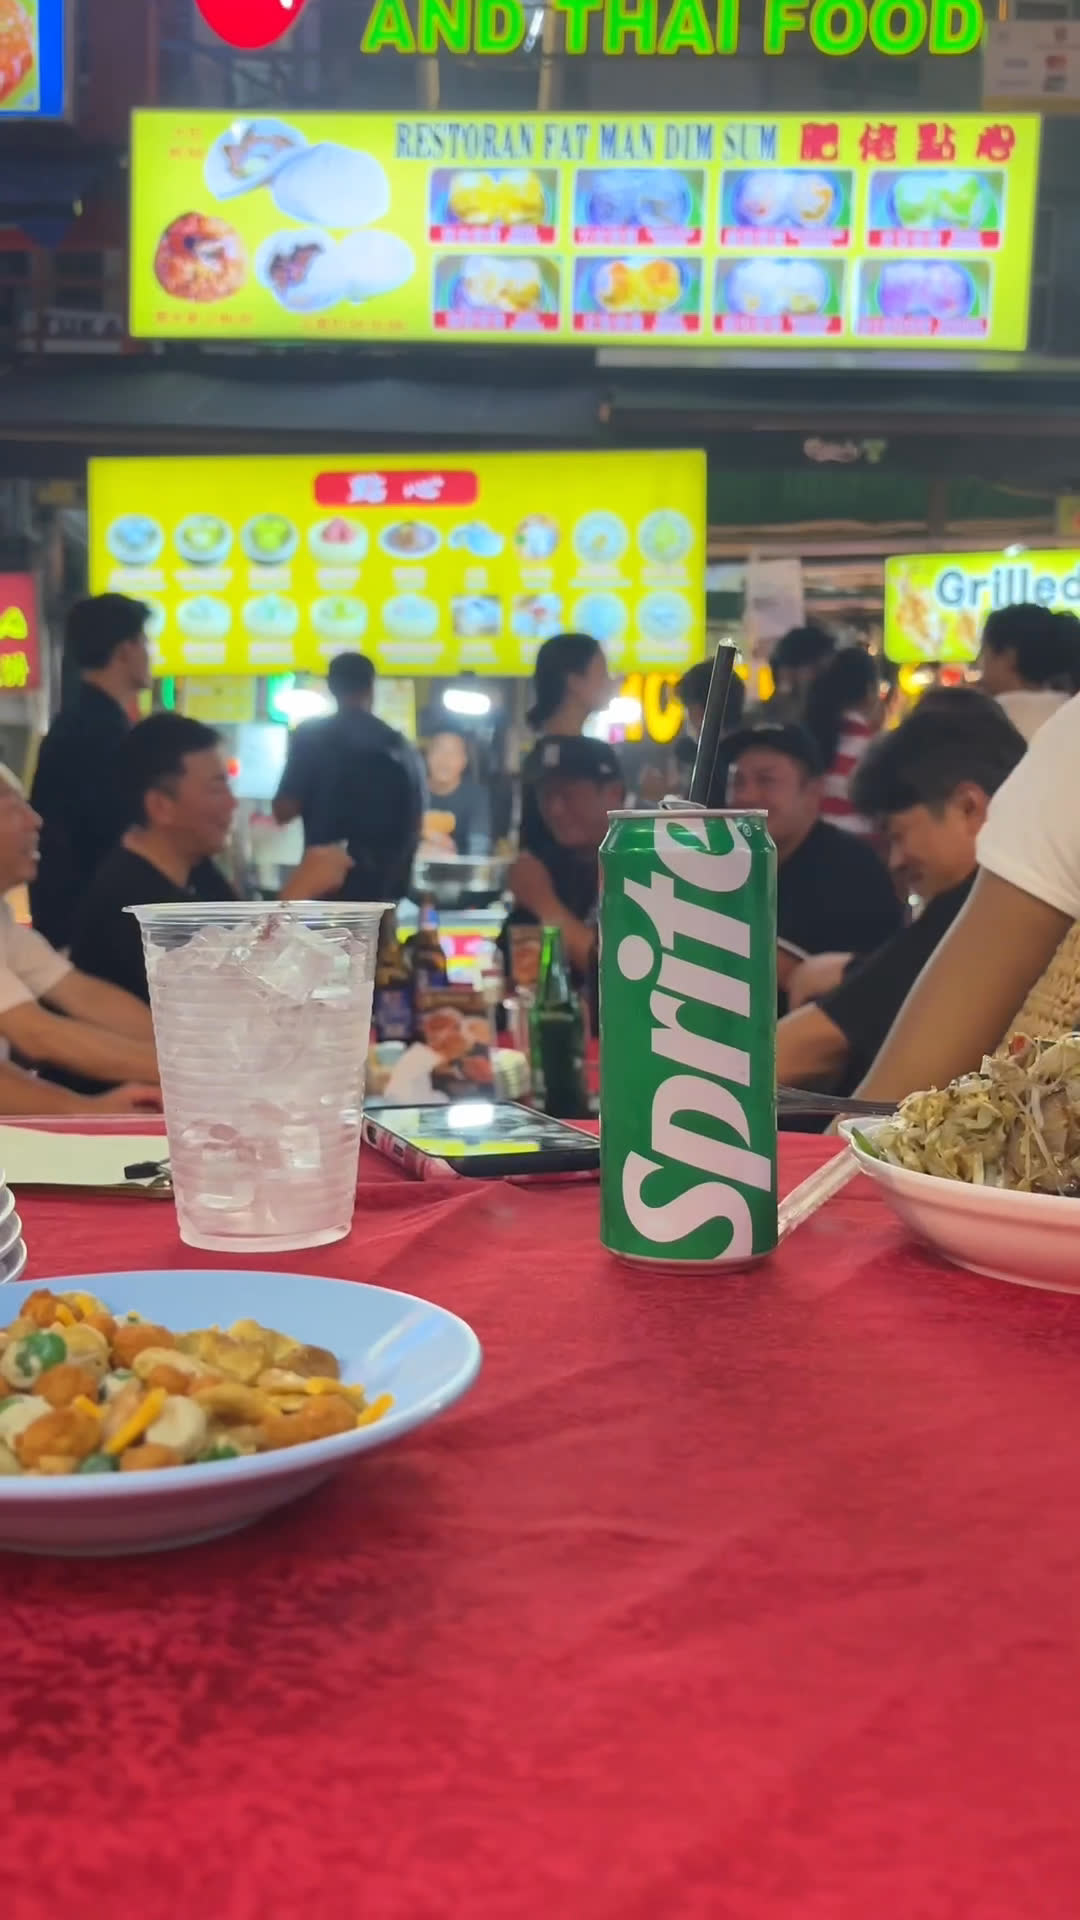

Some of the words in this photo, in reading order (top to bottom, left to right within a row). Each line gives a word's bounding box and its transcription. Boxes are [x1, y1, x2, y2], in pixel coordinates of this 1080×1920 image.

[361, 0, 528, 54] AND
[555, 0, 740, 55] THAI
[764, 0, 984, 56] FOOD
[396, 122, 534, 159] RESTORAN
[543, 123, 590, 160] FAT
[599, 123, 655, 161] MAN
[664, 124, 714, 161] DIM
[722, 124, 778, 161] SUM
[617, 817, 772, 1261] Sprite
